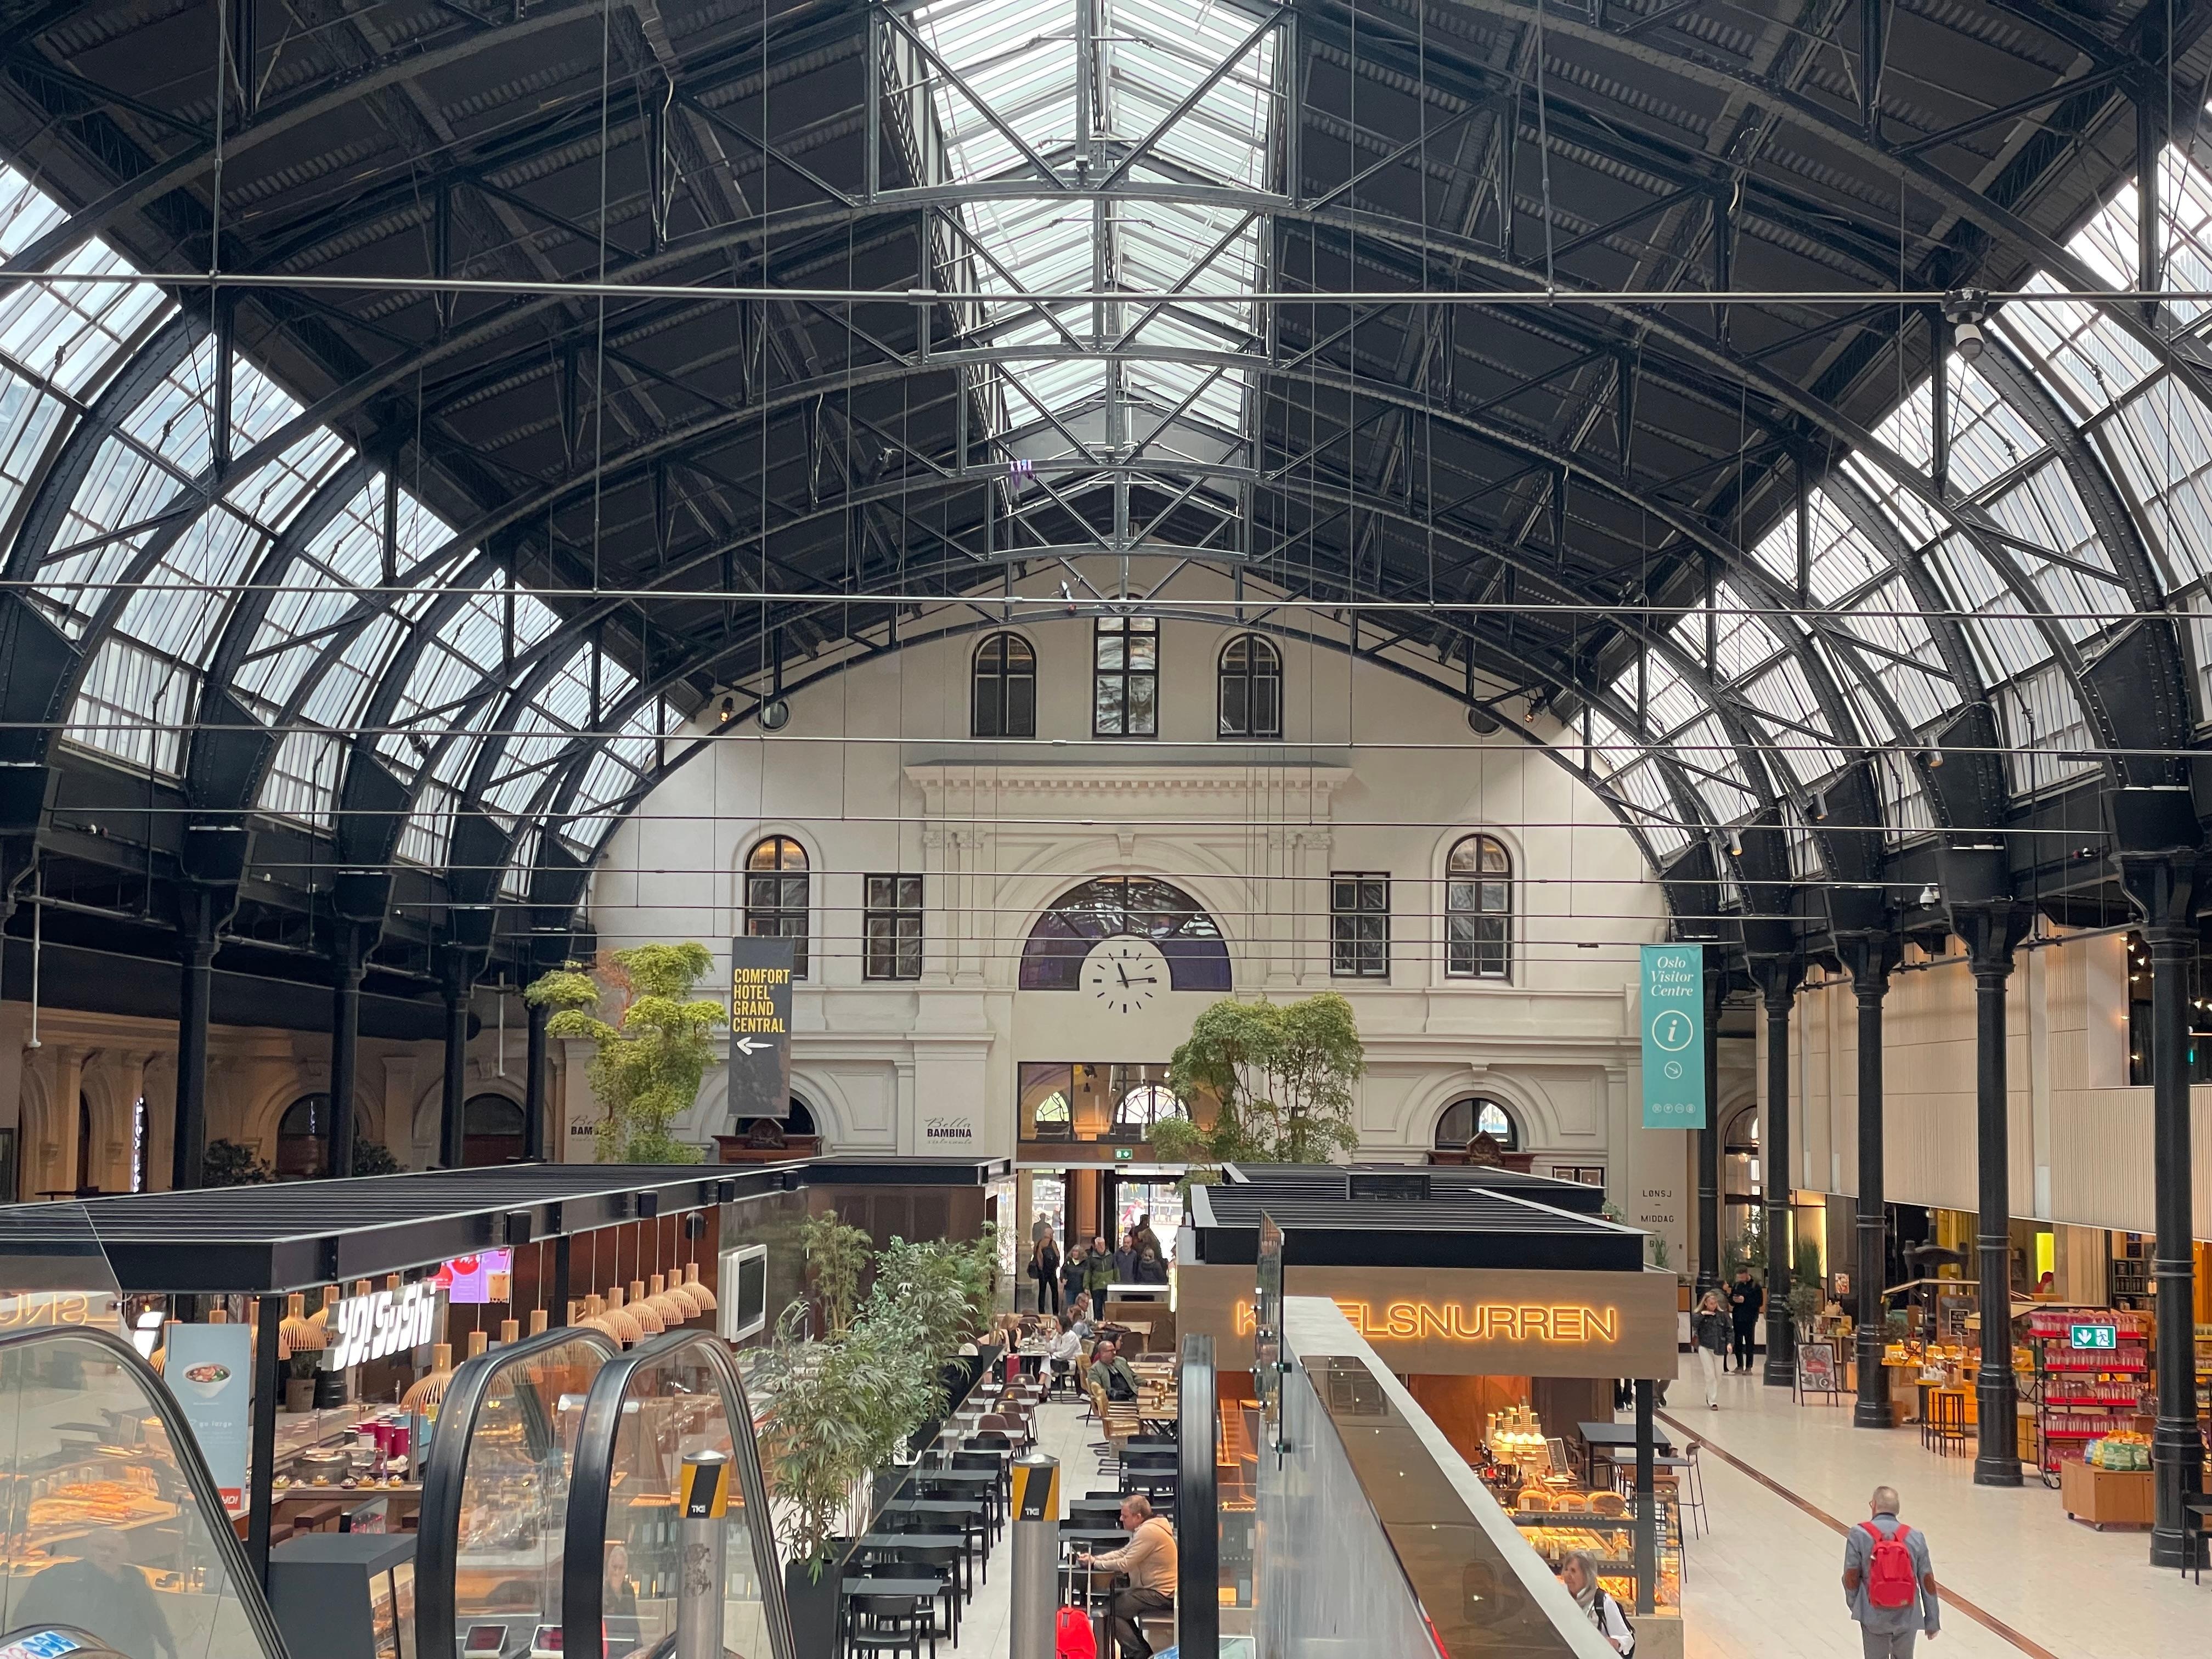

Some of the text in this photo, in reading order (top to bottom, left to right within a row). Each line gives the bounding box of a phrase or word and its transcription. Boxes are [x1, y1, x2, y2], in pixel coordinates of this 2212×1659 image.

[1657, 956, 1686, 968] Oslo
[735, 968, 790, 984] COMFORT
[1651, 970, 1694, 982] Visitor
[1651, 985, 1693, 996] Centre
[733, 1000, 774, 1016] GRAND
[733, 1017, 786, 1032] CENTRAL
[923, 1118, 970, 1127] Bella
[927, 1128, 972, 1137] BAMBINA
